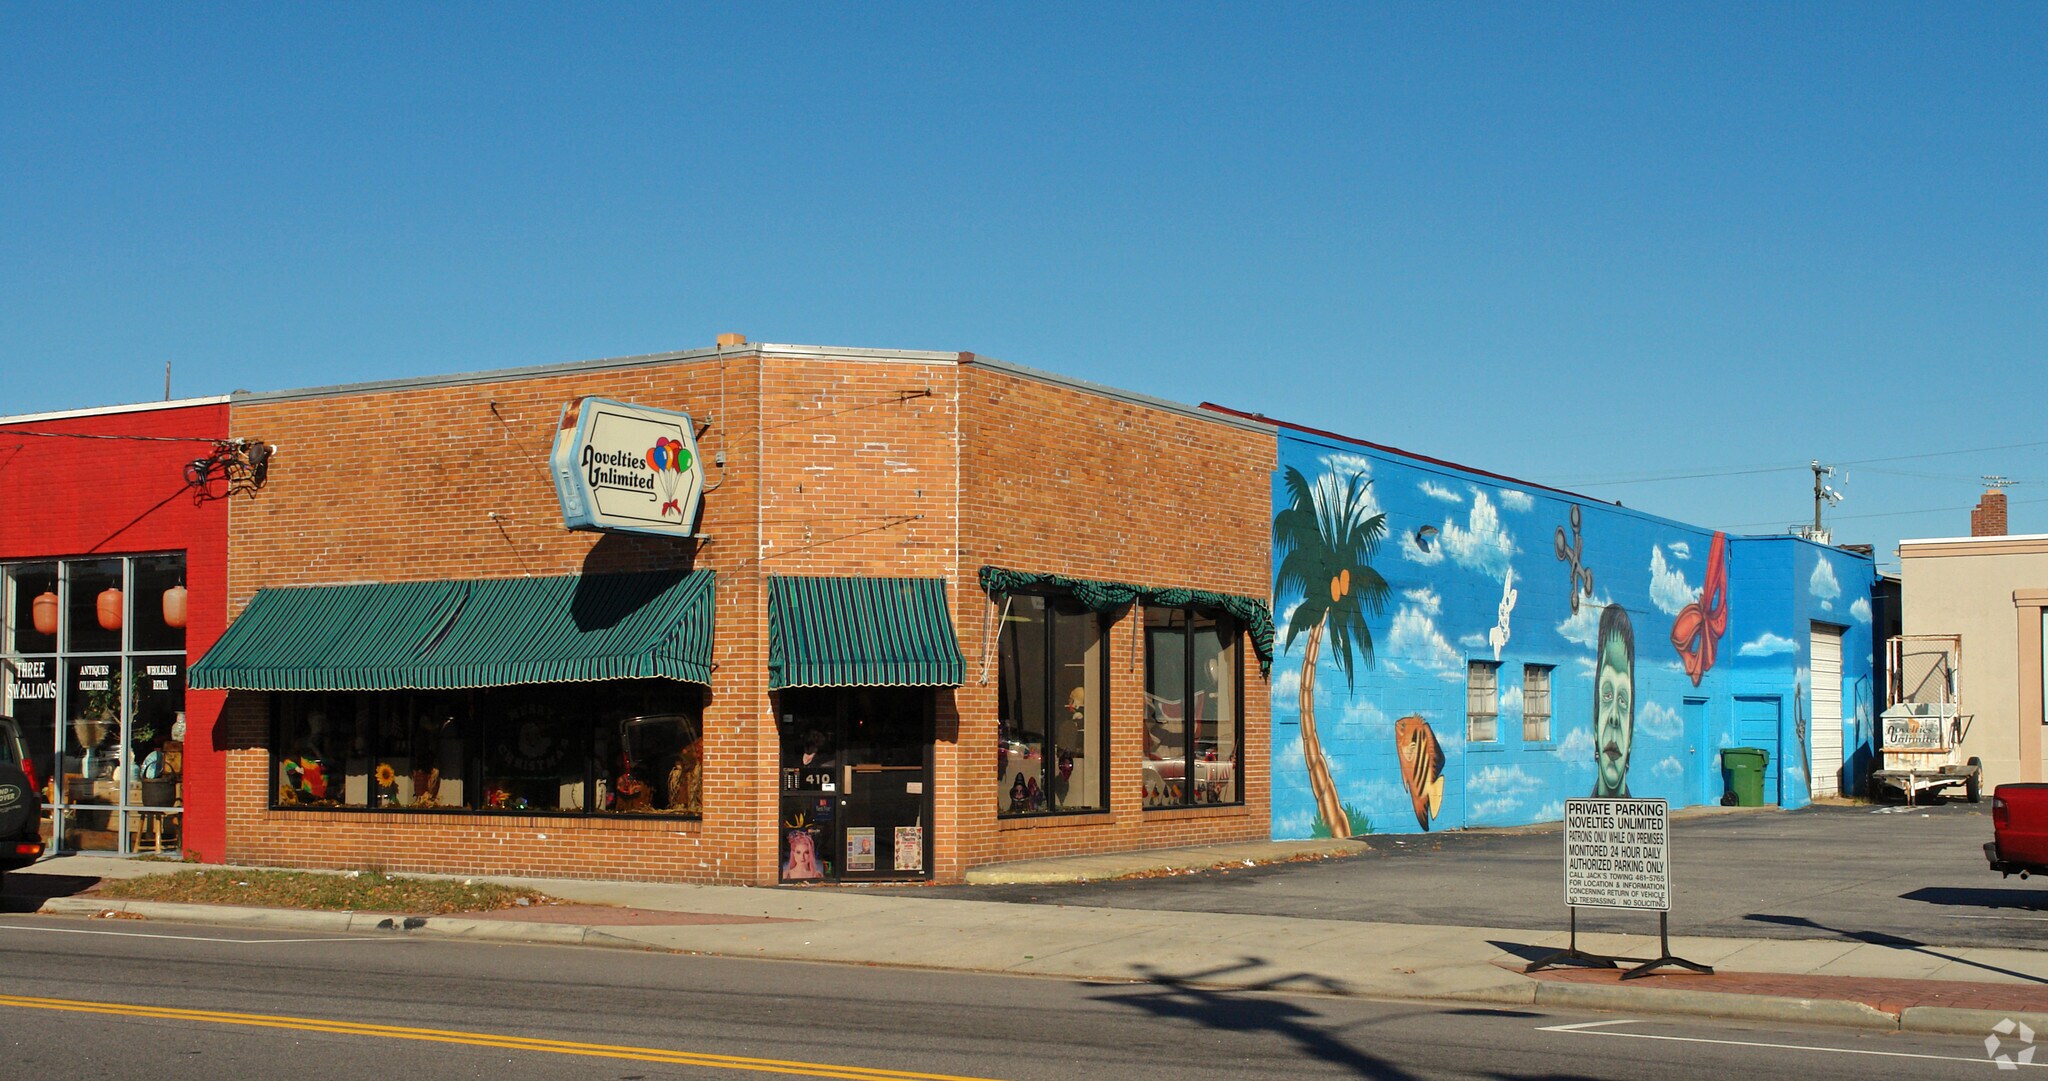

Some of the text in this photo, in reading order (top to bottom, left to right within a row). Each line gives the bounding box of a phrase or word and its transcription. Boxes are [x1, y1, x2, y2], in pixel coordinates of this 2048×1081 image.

[582, 445, 646, 470] Novelties
[589, 466, 655, 490] Unlimited
[16, 661, 45, 678] THREE
[80, 665, 109, 677] ANTIQUES
[146, 665, 177, 676] WHOLESALE
[7, 680, 57, 699] SWALLOWS
[79, 679, 109, 691] COLLECTIBLES
[153, 679, 169, 690] RETAIL
[805, 774, 830, 785] 410
[1569, 803, 1663, 816] PRIVATE PARKING
[1569, 817, 1663, 830] NOVELTIES UNLIMITED
[1569, 831, 1664, 845] PATRONS ONLY WHILE ON PREMISES
[1569, 845, 1661, 859] MONITORED 24 HOUR DAILY
[1569, 858, 1664, 873] AUTHORIZED PARKING ONLY
[1569, 871, 1584, 879] CALL
[1610, 873, 1633, 881] TOWING
[1584, 880, 1613, 888] LOCATION
[1623, 882, 1665, 890] INFORMATION
[1570, 888, 1665, 899] CONCERNING RETURN OF VEHICLE
[1579, 897, 1616, 905] TRESPASSING
[1634, 900, 1665, 908] SOLICITING
